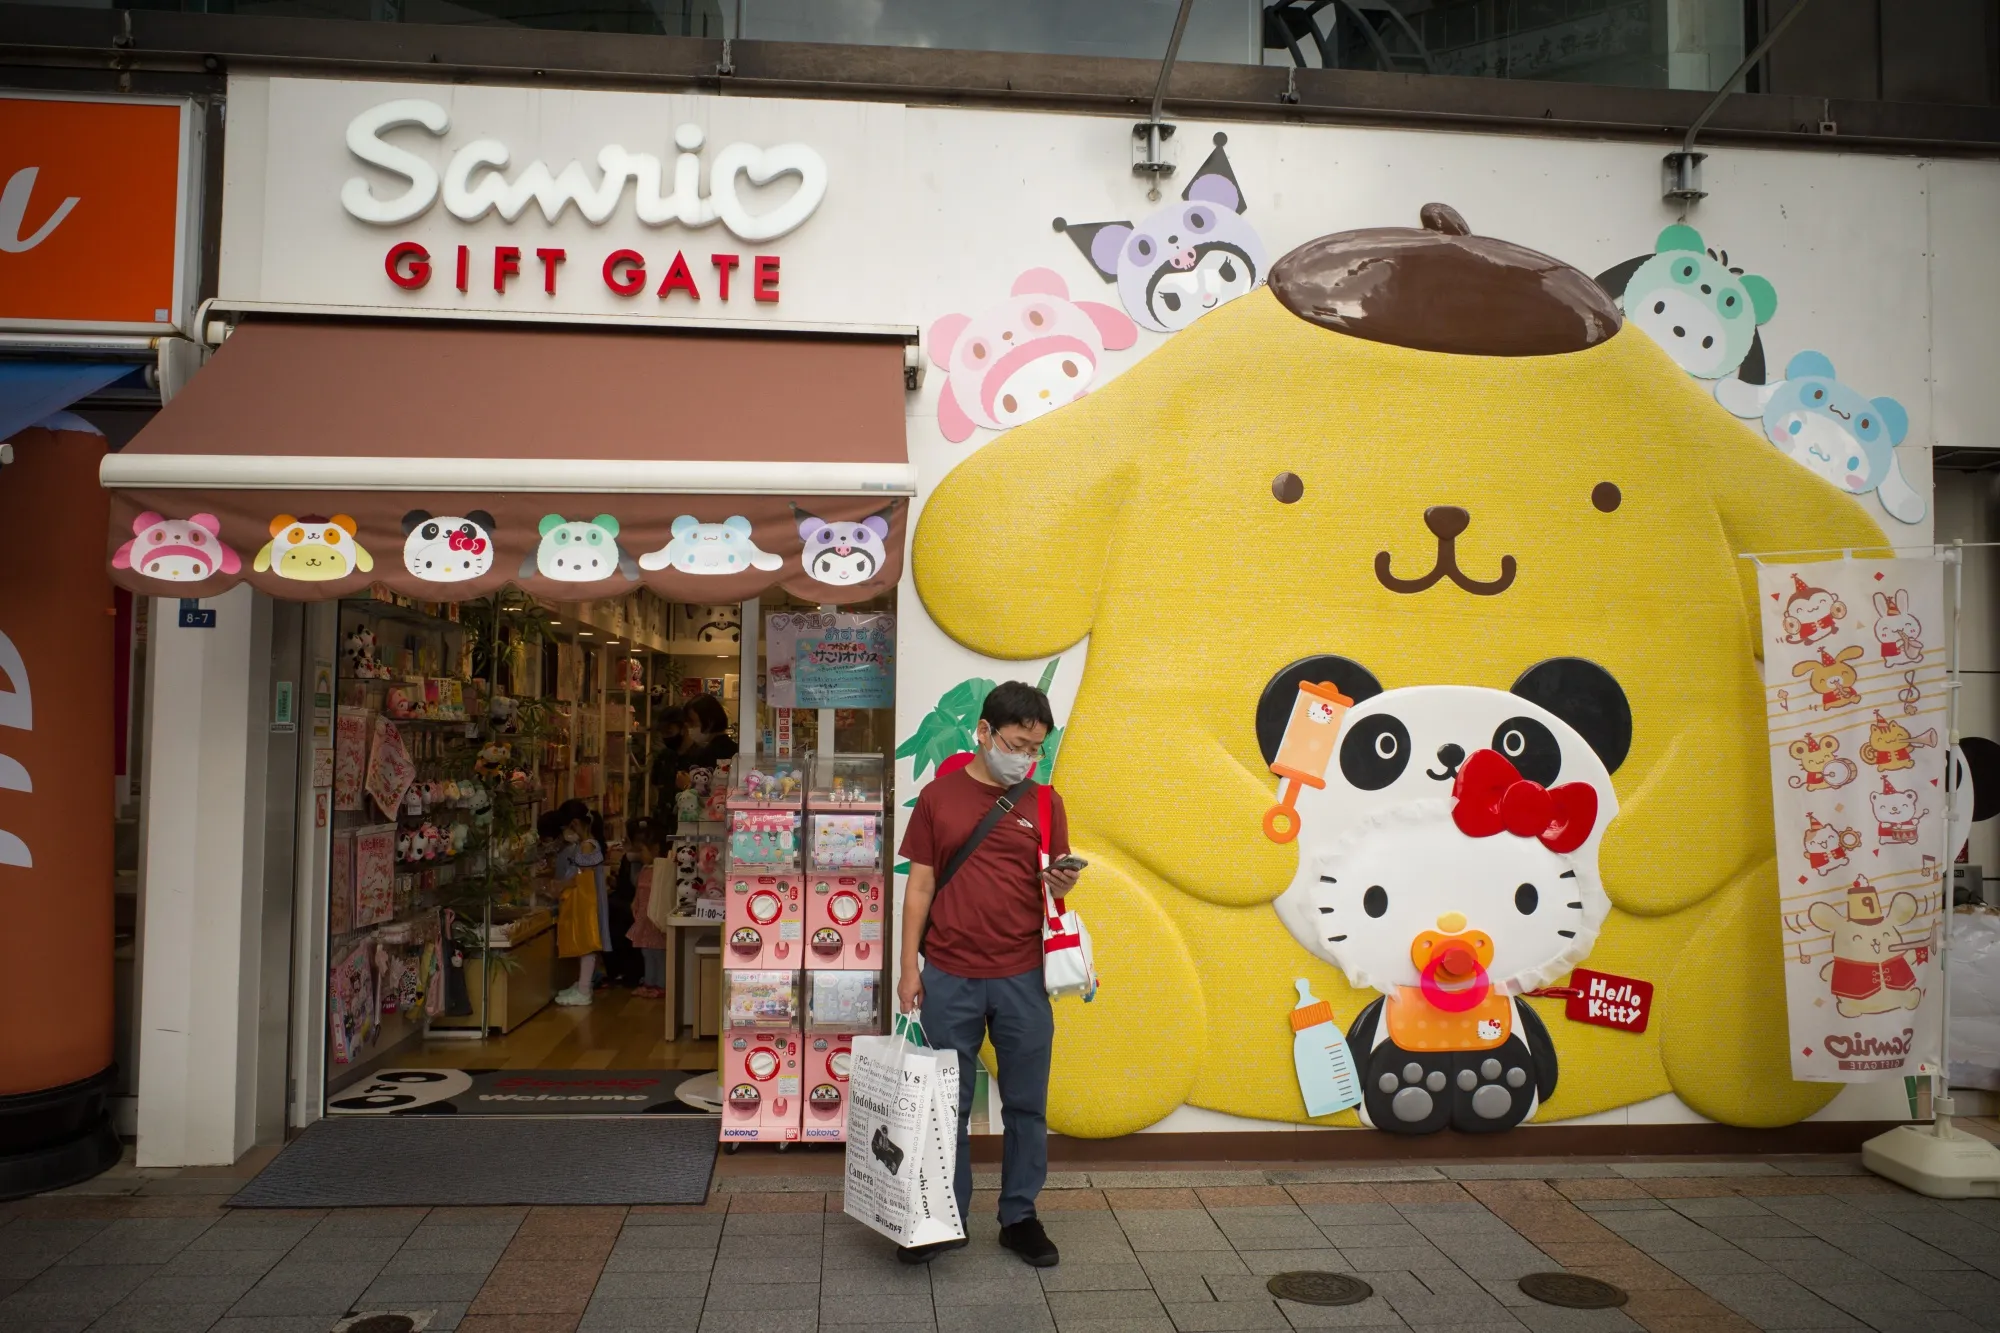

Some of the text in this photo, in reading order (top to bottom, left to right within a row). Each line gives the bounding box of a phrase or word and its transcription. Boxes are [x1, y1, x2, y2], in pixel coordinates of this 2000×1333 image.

[340, 98, 829, 243] Sanrio
[384, 241, 781, 303] GIFT GATE
[186, 613, 209, 624] 8-7
[791, 613, 837, 630] 今週の
[1588, 977, 1642, 1006] Hello
[1588, 998, 1643, 1025] Kitty
[478, 1093, 650, 1102] Welcome
[852, 1090, 890, 1117] Yodobashi
[848, 1162, 874, 1187] Camera
